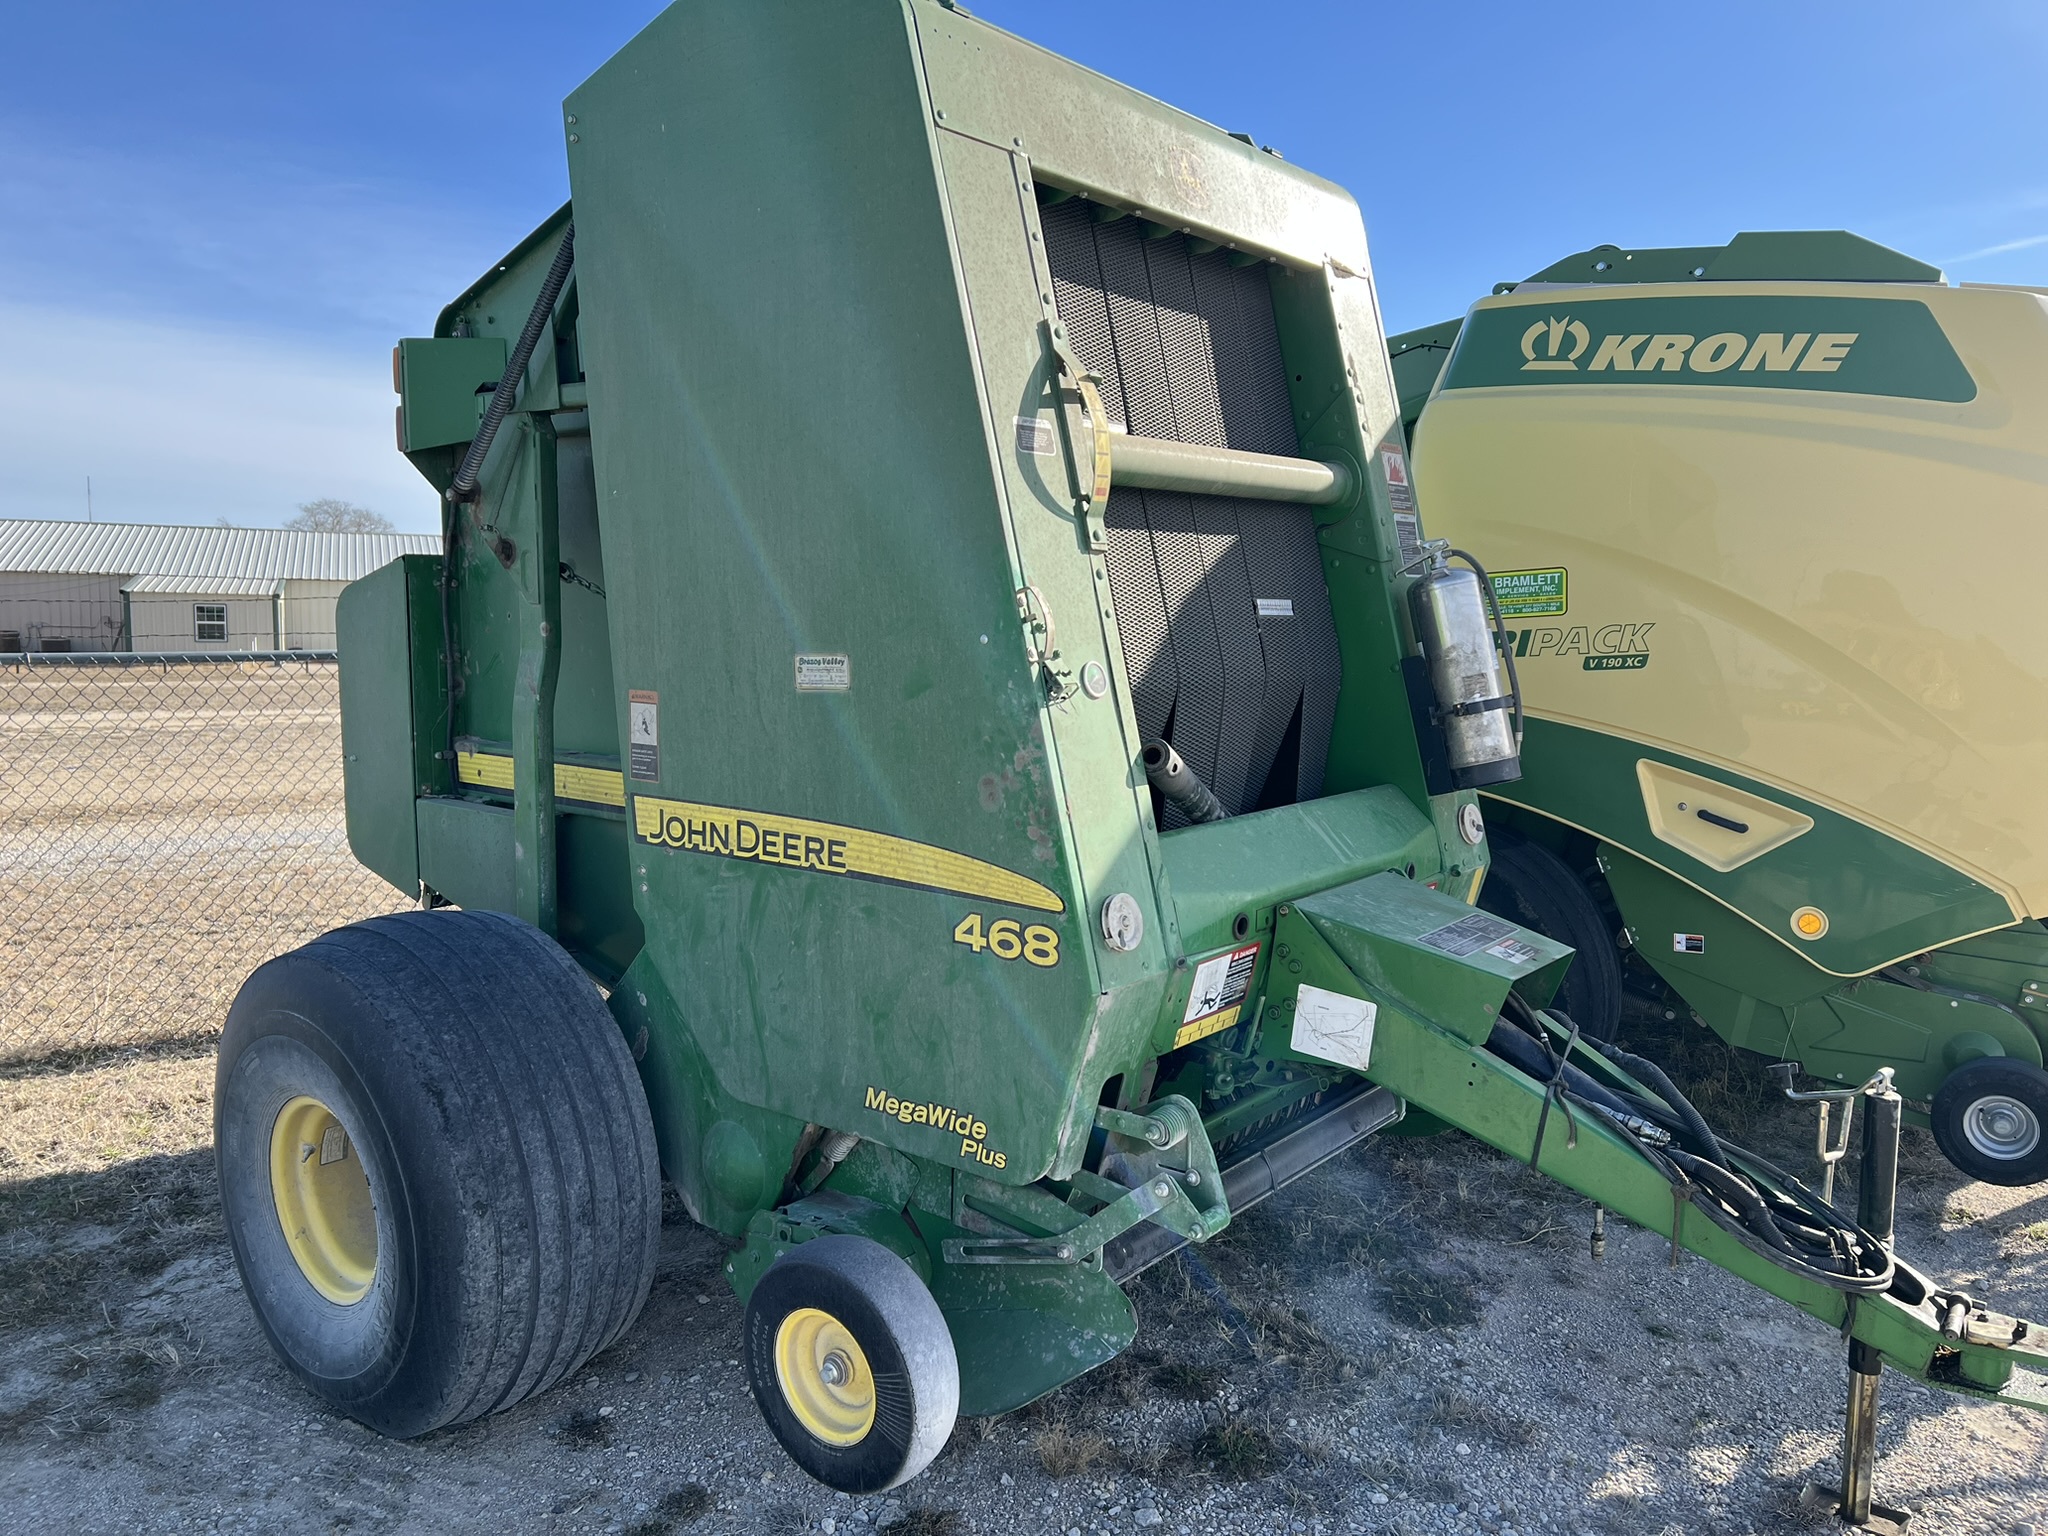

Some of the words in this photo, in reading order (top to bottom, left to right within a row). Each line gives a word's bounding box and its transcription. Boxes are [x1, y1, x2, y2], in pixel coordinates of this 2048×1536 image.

[1587, 333, 1860, 373] KRONE
[1494, 573, 1560, 588] BRAMLETT
[1496, 586, 1540, 595] IMPLEMENT,
[1589, 658, 1599, 668] V
[1602, 658, 1622, 668] 190
[1625, 657, 1643, 667] XC
[649, 808, 729, 851] JOHN
[736, 819, 847, 869] DEERE
[954, 913, 1060, 967] 468
[1239, 946, 1258, 958] DANGER
[864, 1086, 988, 1140] MegaWide
[960, 1138, 1007, 1169] Plus
